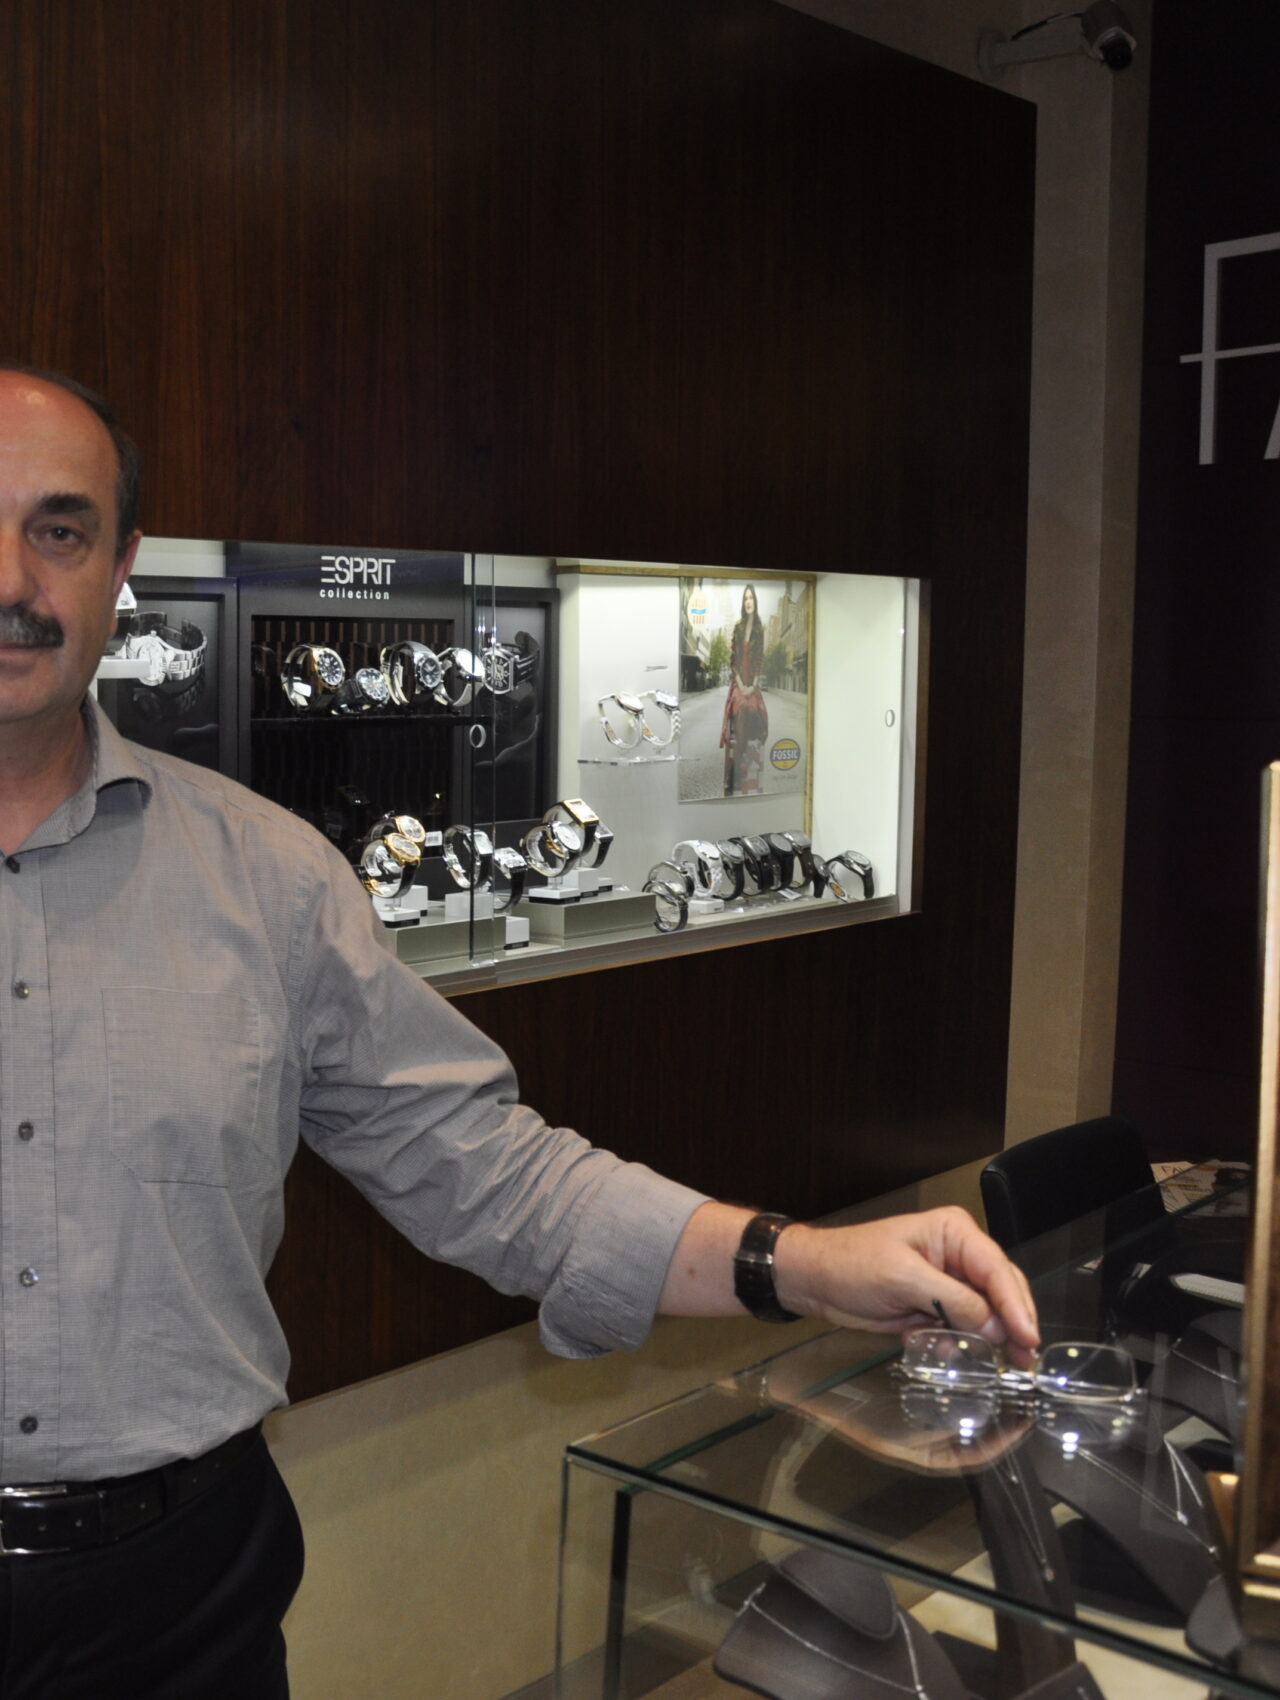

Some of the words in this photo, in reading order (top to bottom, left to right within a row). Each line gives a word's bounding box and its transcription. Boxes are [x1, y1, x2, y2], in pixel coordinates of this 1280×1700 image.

[1178, 232, 1280, 465] F
[321, 555, 396, 585] ESPRIT
[320, 588, 390, 600] collection
[772, 749, 798, 761] FOSSIL
